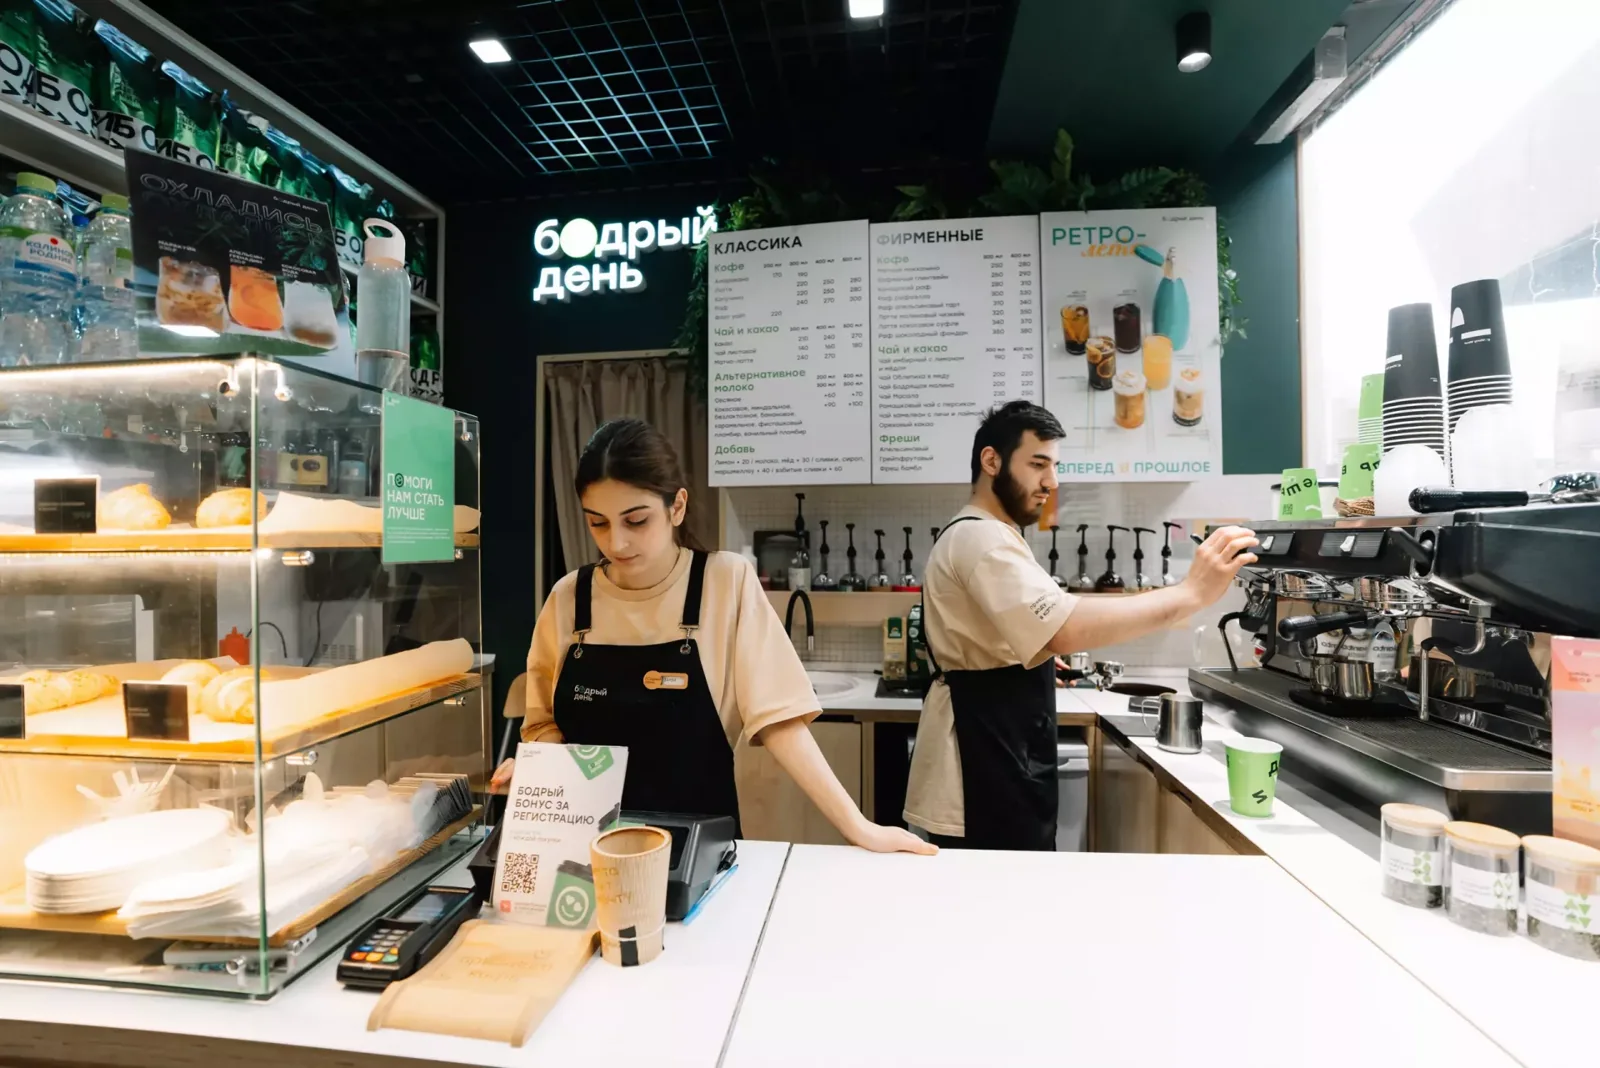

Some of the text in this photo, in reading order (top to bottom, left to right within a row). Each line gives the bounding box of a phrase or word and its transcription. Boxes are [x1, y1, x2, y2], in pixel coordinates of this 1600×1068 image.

[140, 173, 323, 234] ОХЛАДИСЬ
[533, 205, 718, 259] бодрый
[877, 228, 984, 245] ФИРМЕННЫЕ
[714, 236, 802, 255] КЛАССИКА
[877, 256, 909, 264] Кофе
[714, 262, 744, 273] Кофе
[532, 261, 644, 301] день
[714, 326, 734, 336] Чай
[747, 326, 779, 334] какао
[878, 345, 900, 354] Чай
[913, 345, 948, 353] какао
[714, 370, 806, 382] Альтернативное
[714, 384, 754, 392] молоко
[879, 435, 920, 445] Фреши
[714, 444, 755, 455] Добавь
[1058, 462, 1115, 475] ВПЕРЕД
[1134, 461, 1210, 473] ПРОШЛОЕ
[387, 489, 445, 507] НАМ СТАТЬ
[387, 506, 425, 520] ЛУЧШЕ
[517, 785, 564, 798] БОДРЫЙ
[515, 798, 570, 811] БОНУС ЗА
[512, 811, 595, 826] РЕГИСТРАЦИЮ
